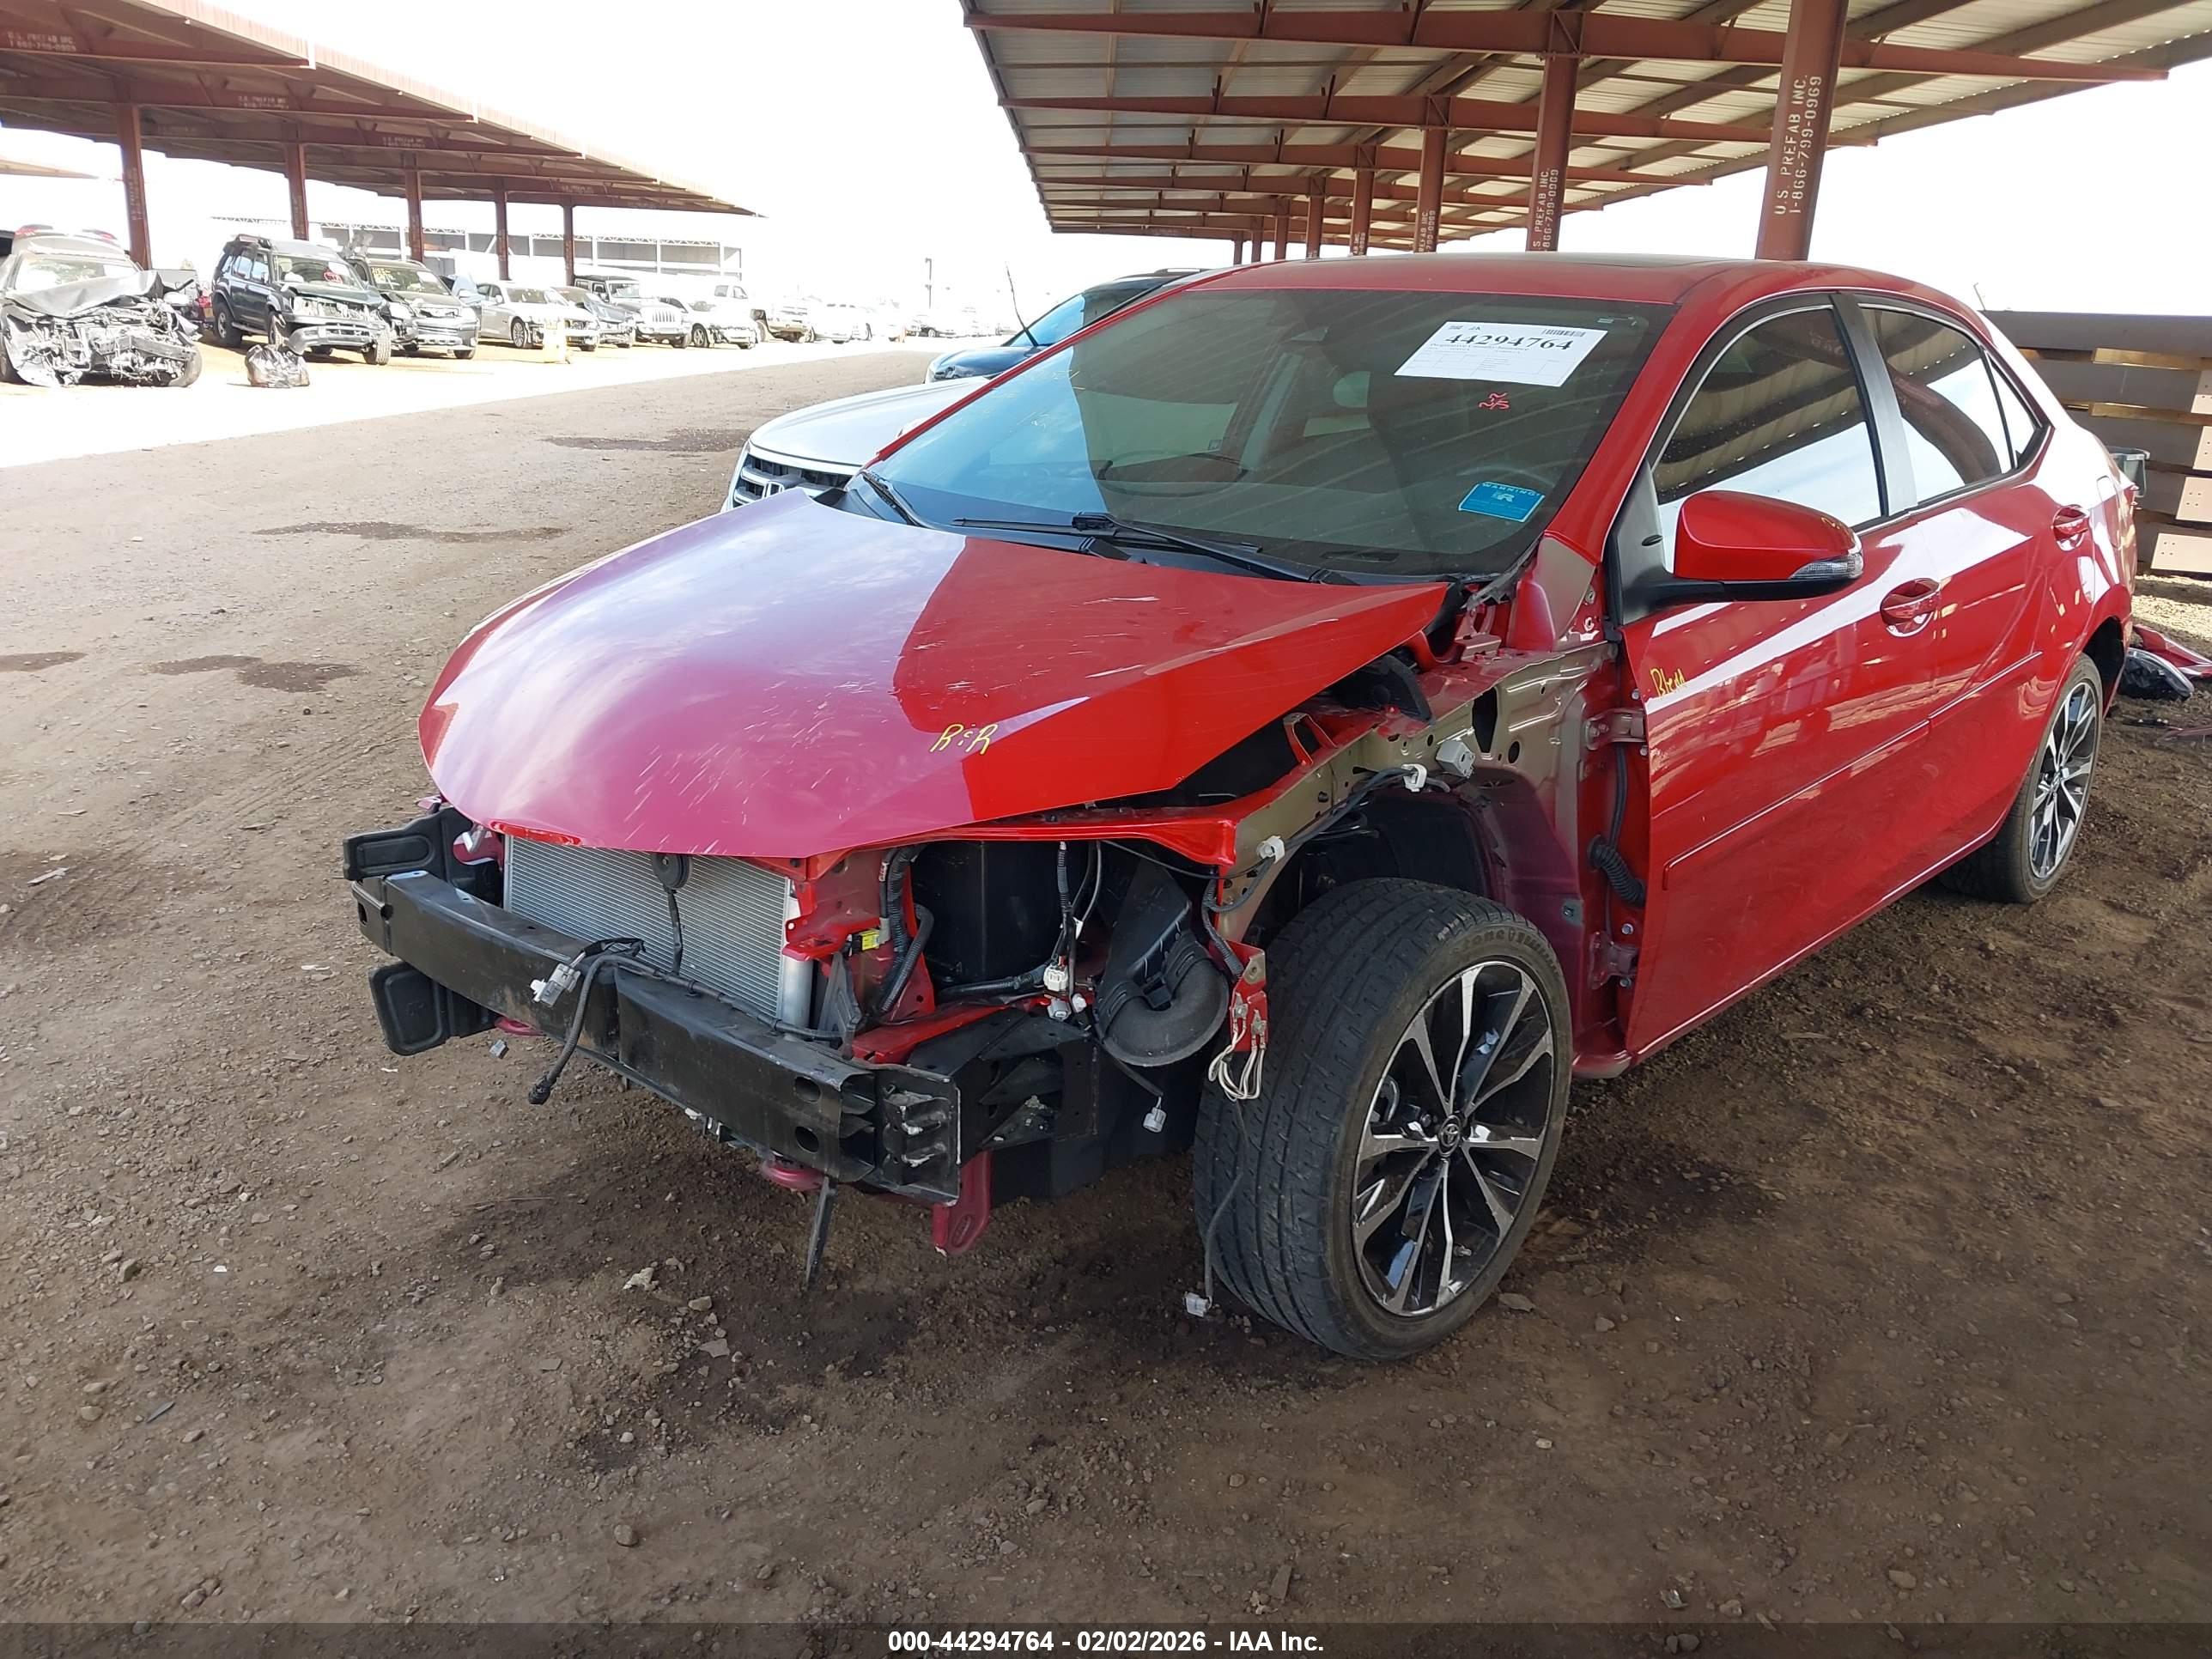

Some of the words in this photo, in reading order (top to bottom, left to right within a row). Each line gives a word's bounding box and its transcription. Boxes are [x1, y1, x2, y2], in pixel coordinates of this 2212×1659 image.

[1780, 112, 1801, 176] PREFAB
[1791, 75, 1808, 105] INC.
[1534, 192, 1547, 233] PREFAB
[1443, 333, 1574, 350] 44294764
